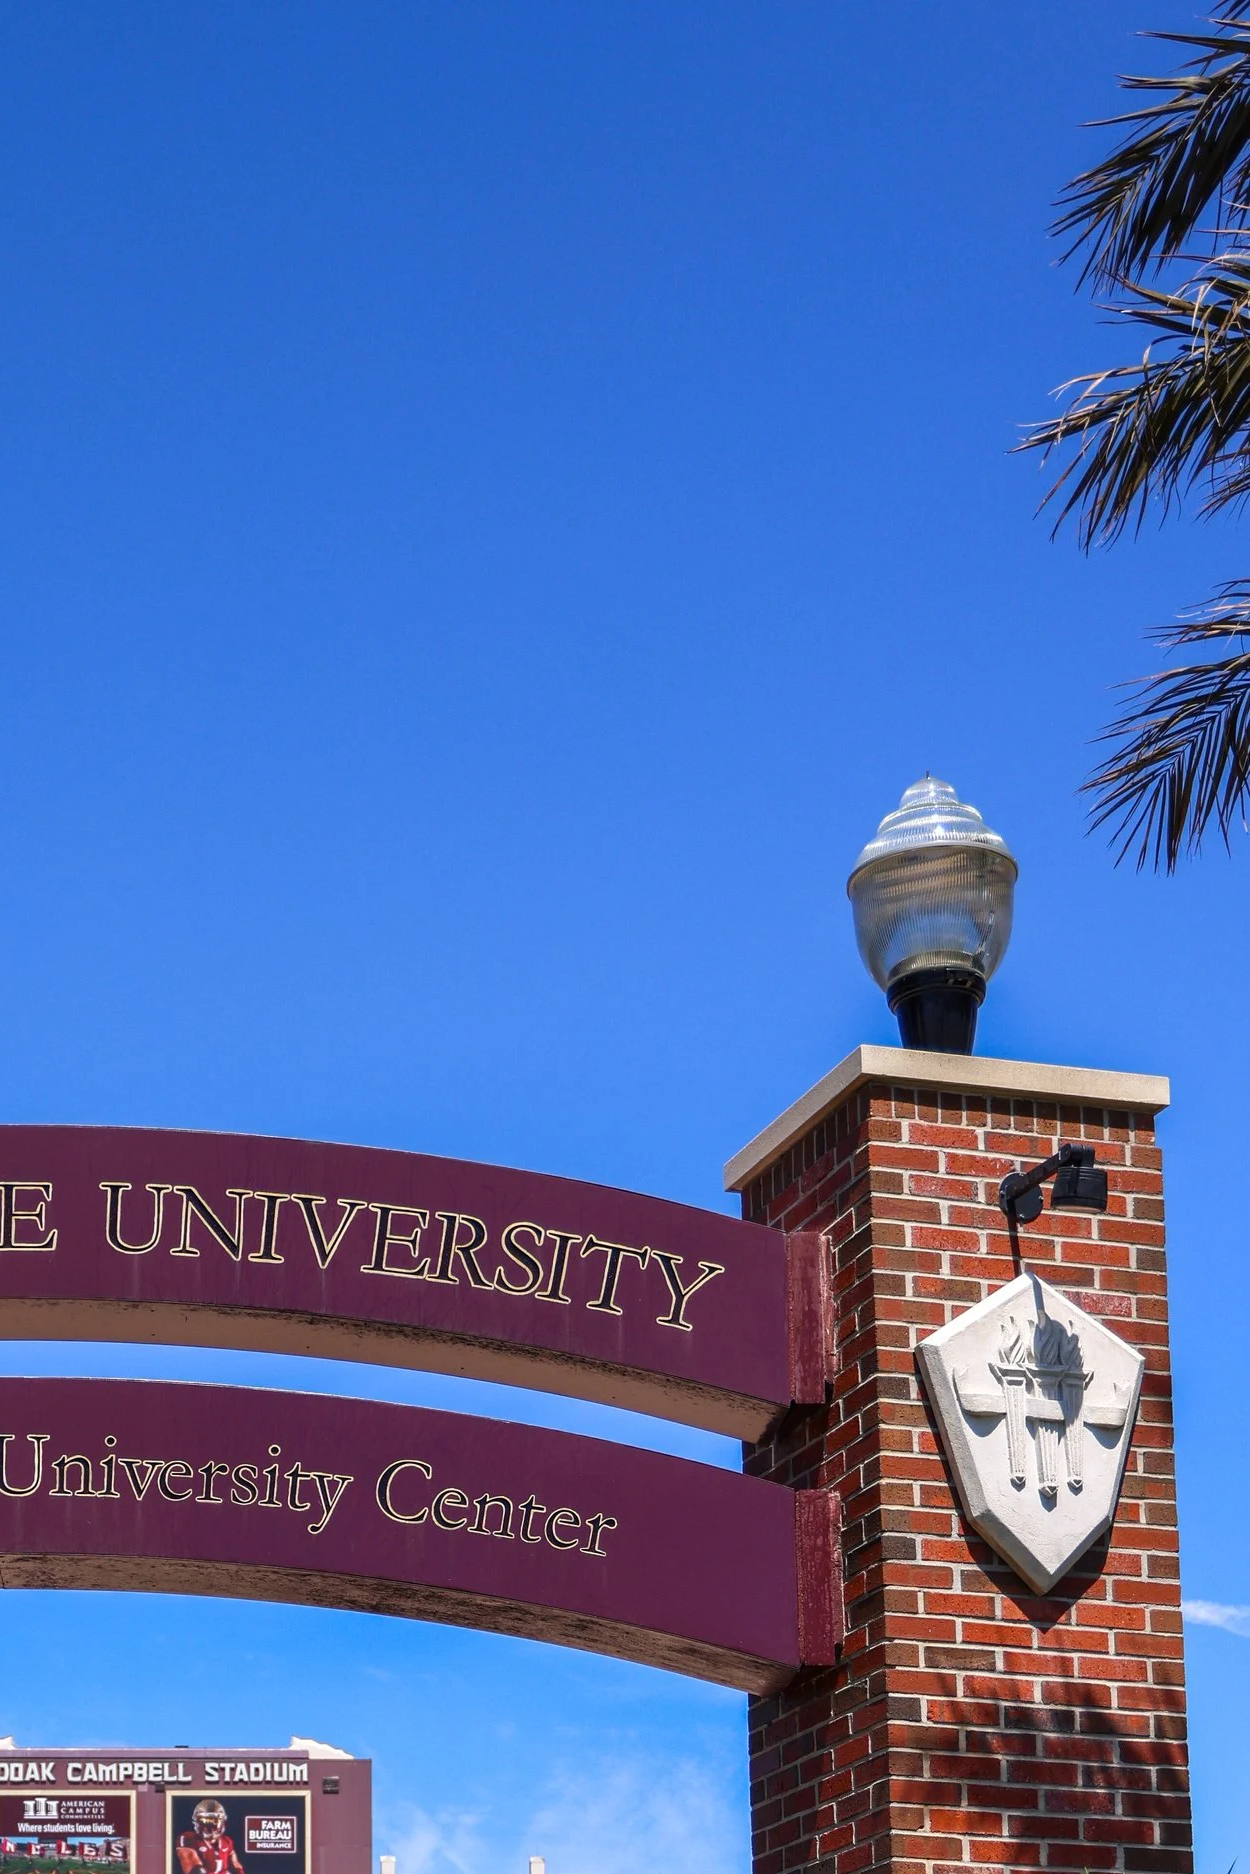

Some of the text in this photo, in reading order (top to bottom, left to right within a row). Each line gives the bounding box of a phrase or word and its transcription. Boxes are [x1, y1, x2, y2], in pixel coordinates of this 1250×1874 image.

[100, 1182, 725, 1331] UNIVERSITY
[375, 1459, 618, 1557] Center
[67, 1762, 193, 1782] CAMPBELL
[205, 1762, 309, 1782] STADIUM
[17, 1823, 42, 1832] Where
[43, 1822, 75, 1833] students
[76, 1822, 91, 1833] love
[261, 1820, 291, 1829] FARM
[249, 1830, 292, 1839] BUREAU
